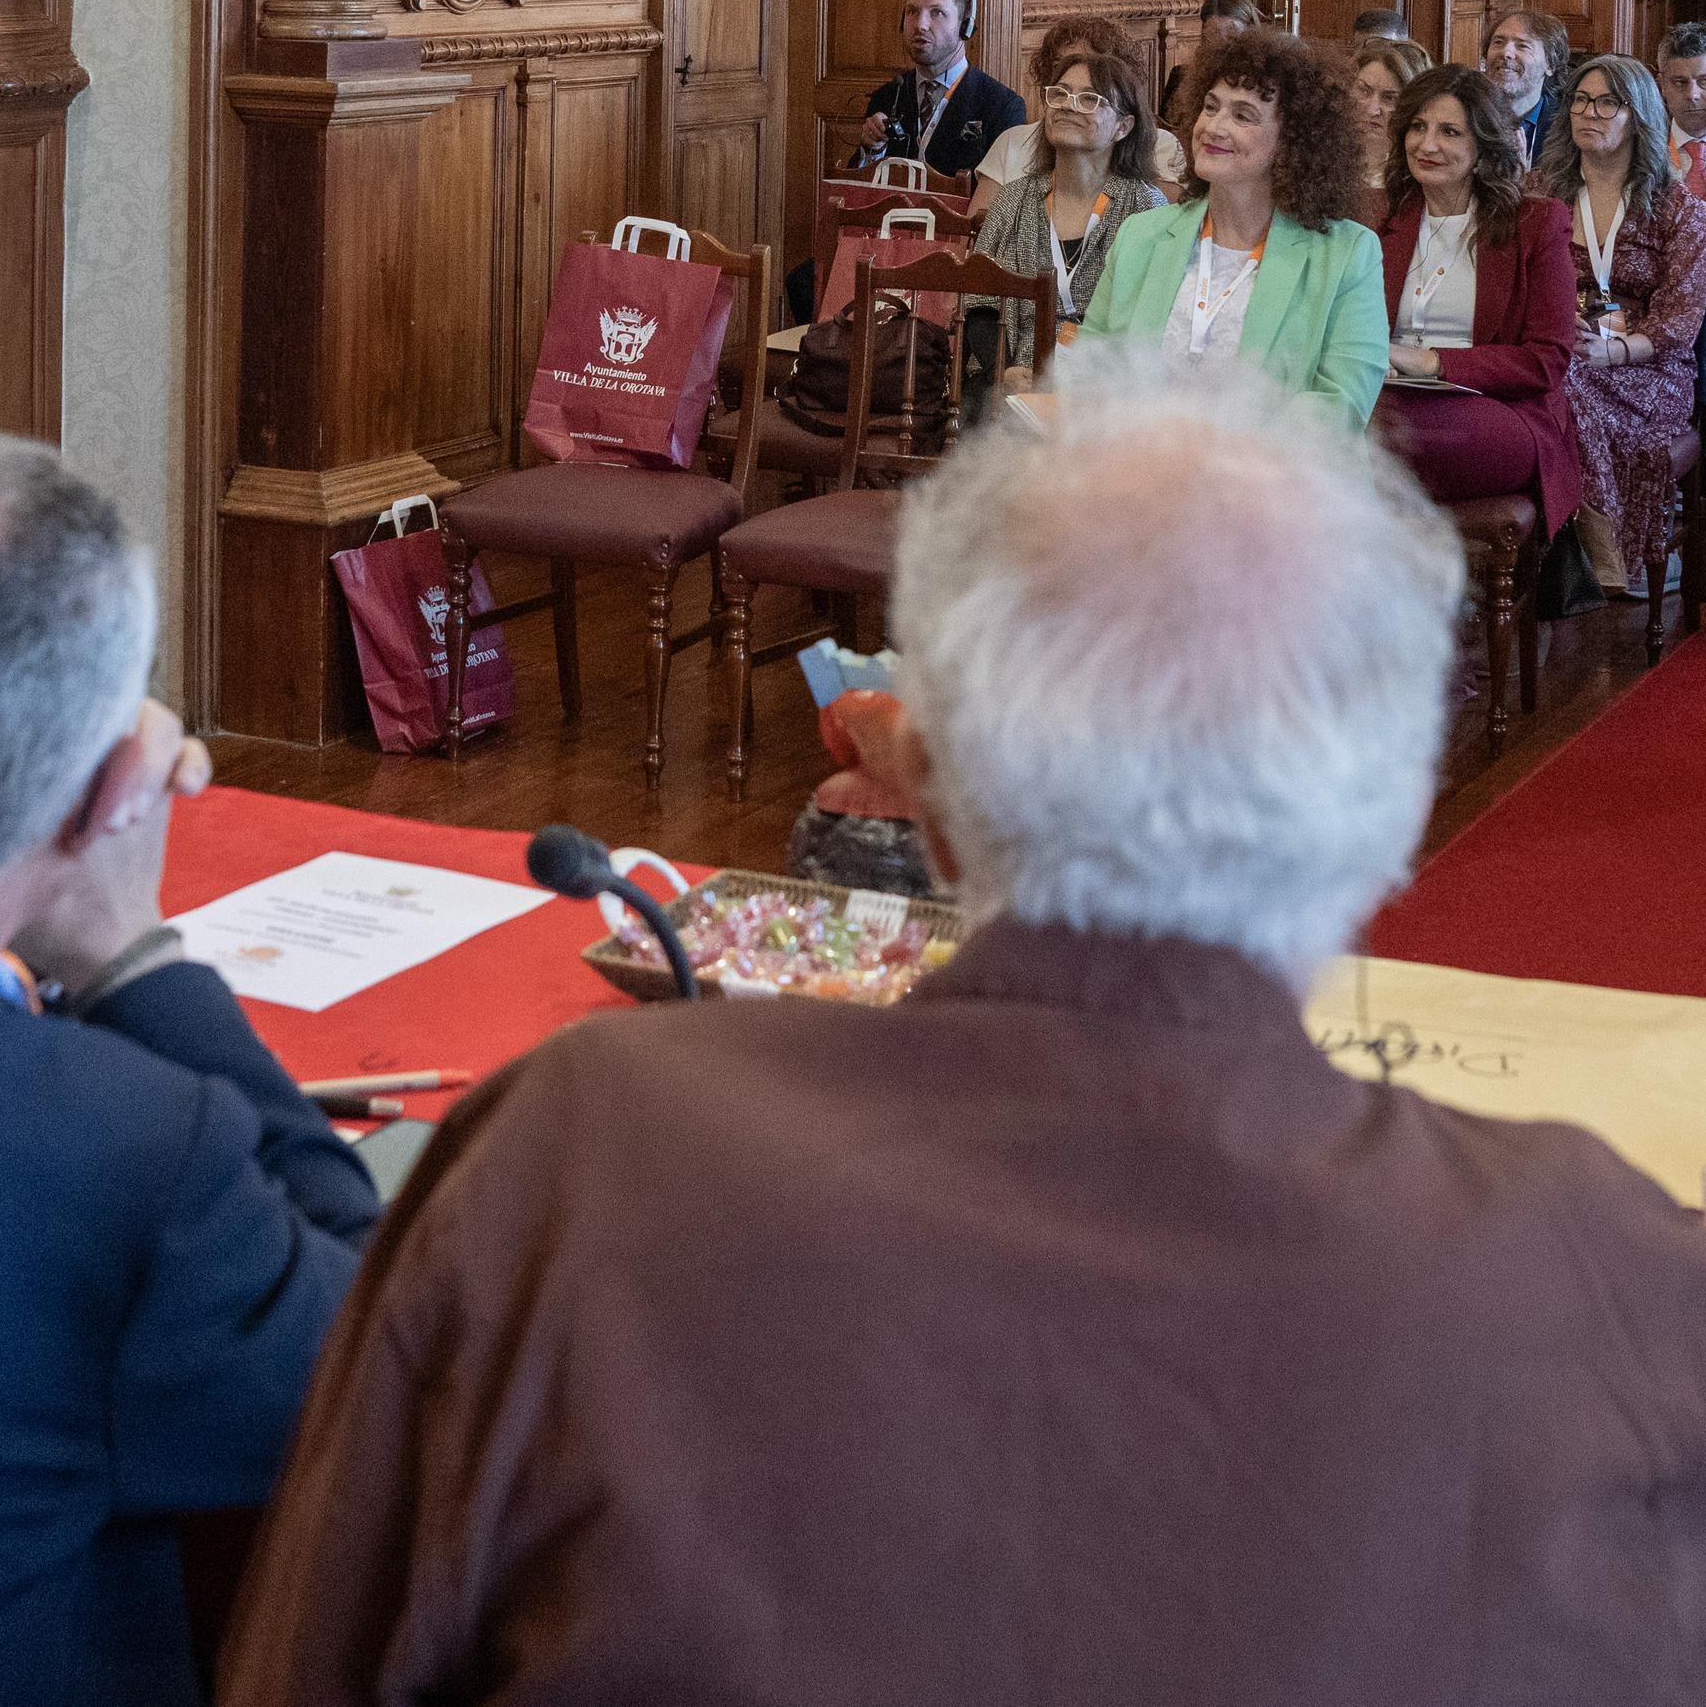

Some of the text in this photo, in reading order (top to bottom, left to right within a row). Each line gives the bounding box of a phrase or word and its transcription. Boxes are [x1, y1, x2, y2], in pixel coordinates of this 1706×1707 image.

[553, 369, 666, 397] VILLA DE LA OROTAVA
[583, 361, 647, 381] Ayuntamiento
